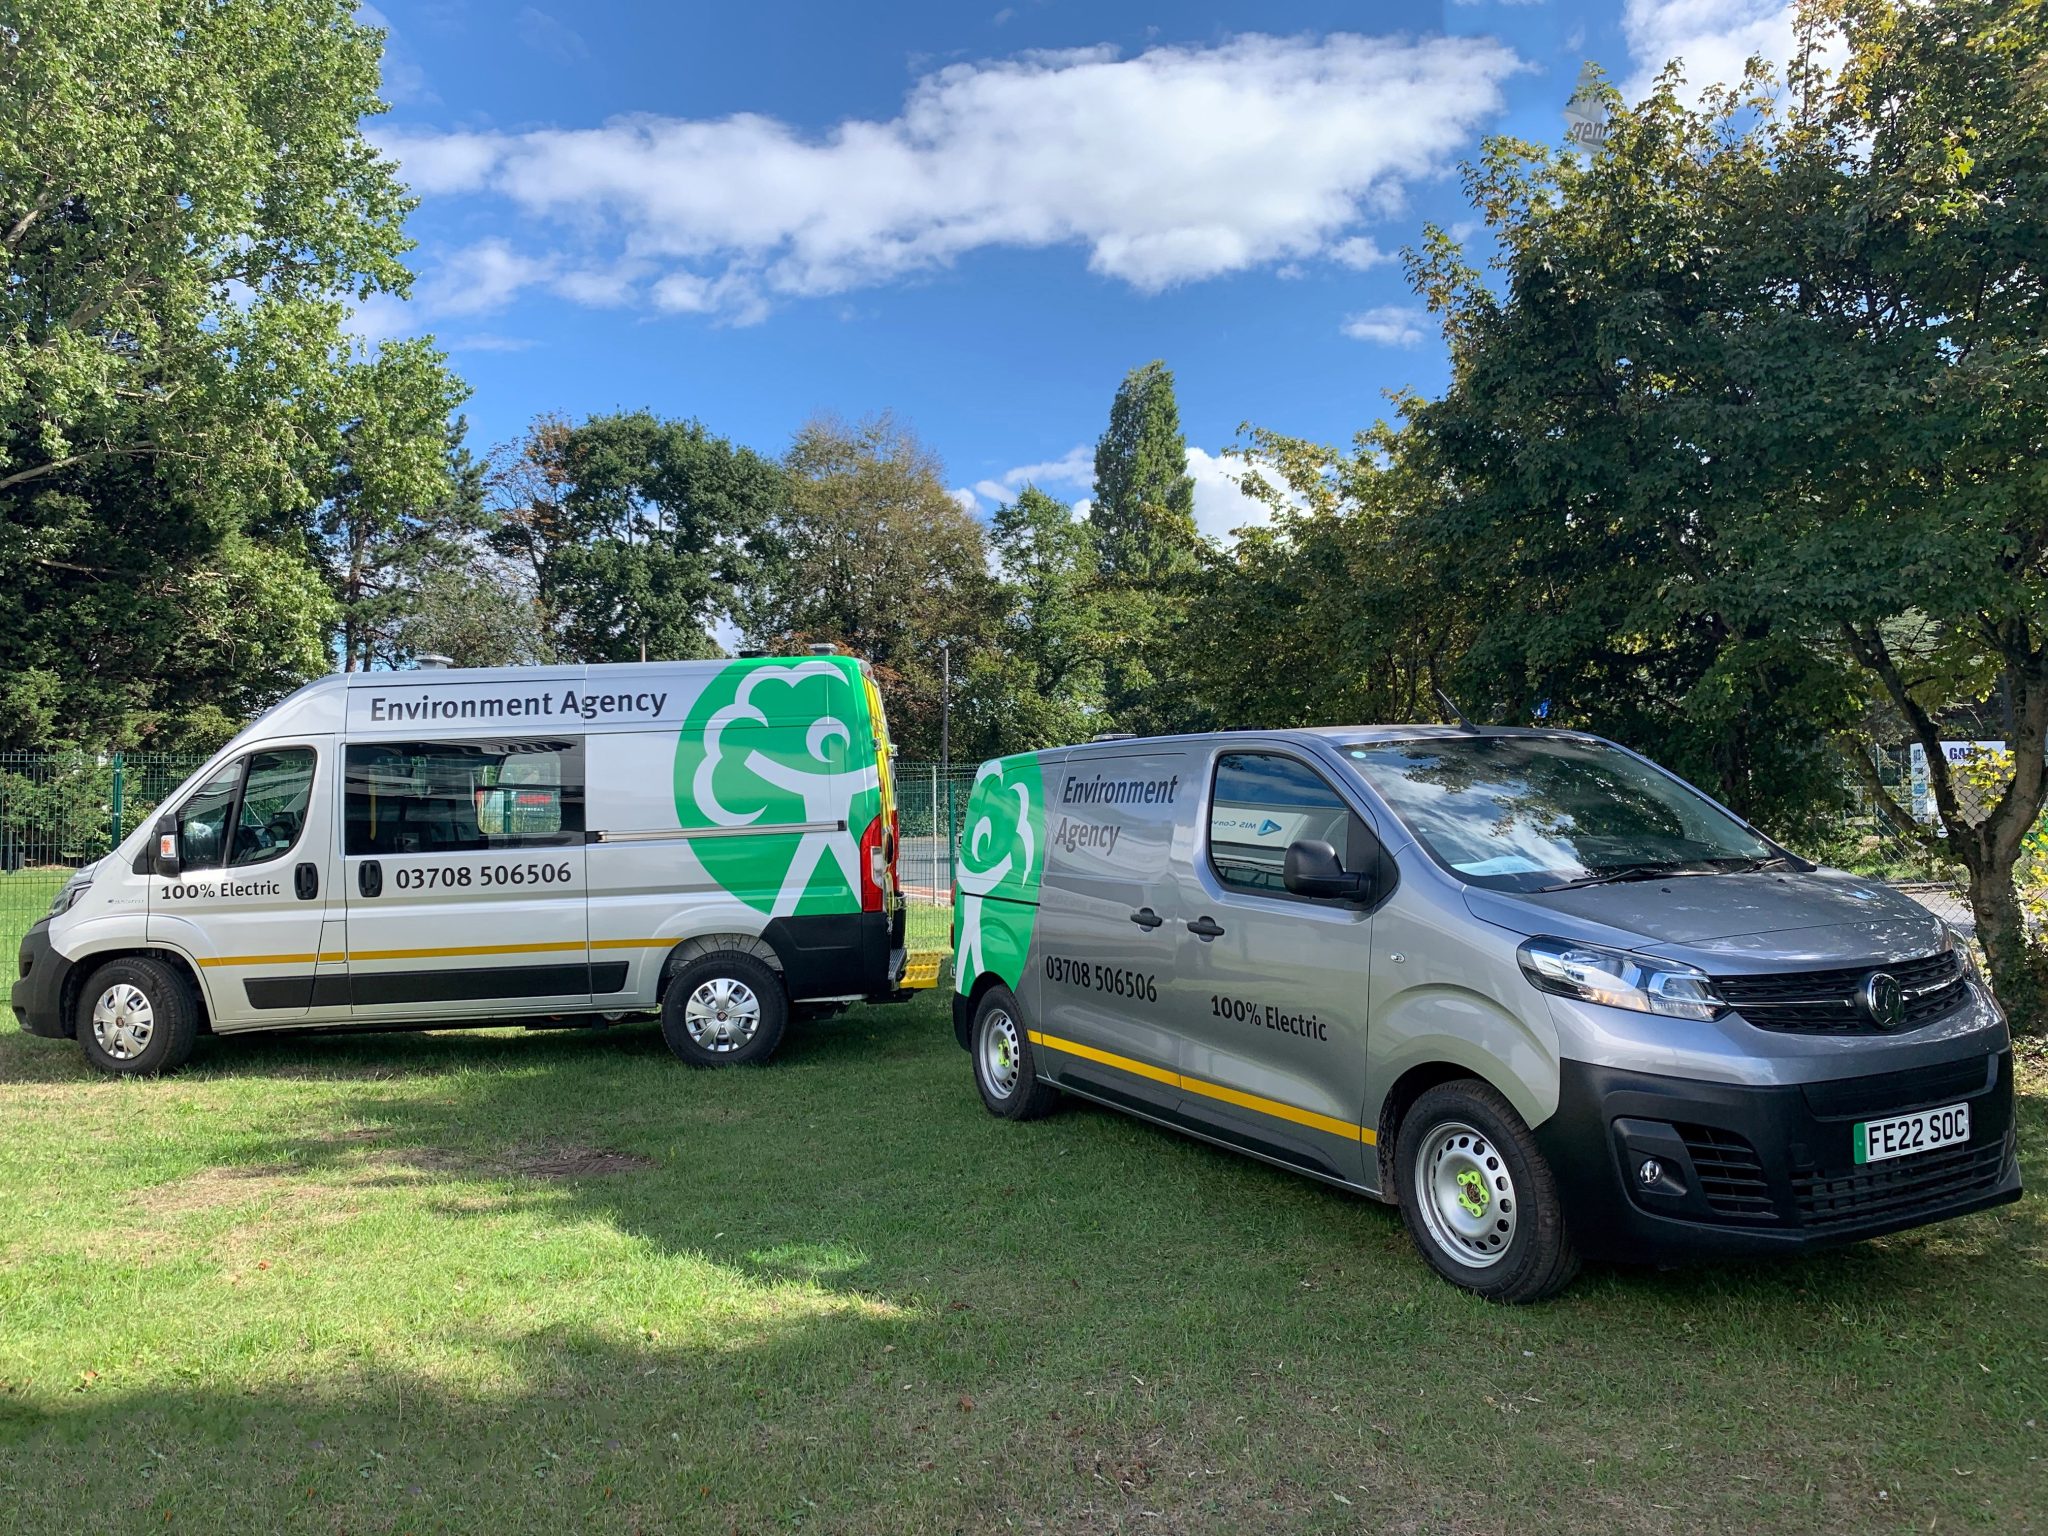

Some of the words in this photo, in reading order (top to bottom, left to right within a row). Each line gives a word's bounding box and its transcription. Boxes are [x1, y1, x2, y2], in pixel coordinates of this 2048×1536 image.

[371, 693, 553, 721] Environment
[560, 690, 667, 719] Agency
[1062, 774, 1178, 804] Environment
[1055, 817, 1121, 856] Agency
[161, 883, 216, 899] 100%
[221, 880, 280, 897] Electric
[396, 866, 472, 889] 03708
[480, 862, 572, 886] 506506
[1045, 955, 1091, 988] 03708
[1096, 965, 1157, 1002] 506506
[1211, 995, 1261, 1026] 100%
[1265, 1006, 1328, 1041] Electric
[1868, 1118, 1924, 1156] FE22
[1930, 1109, 1965, 1143] SOC
